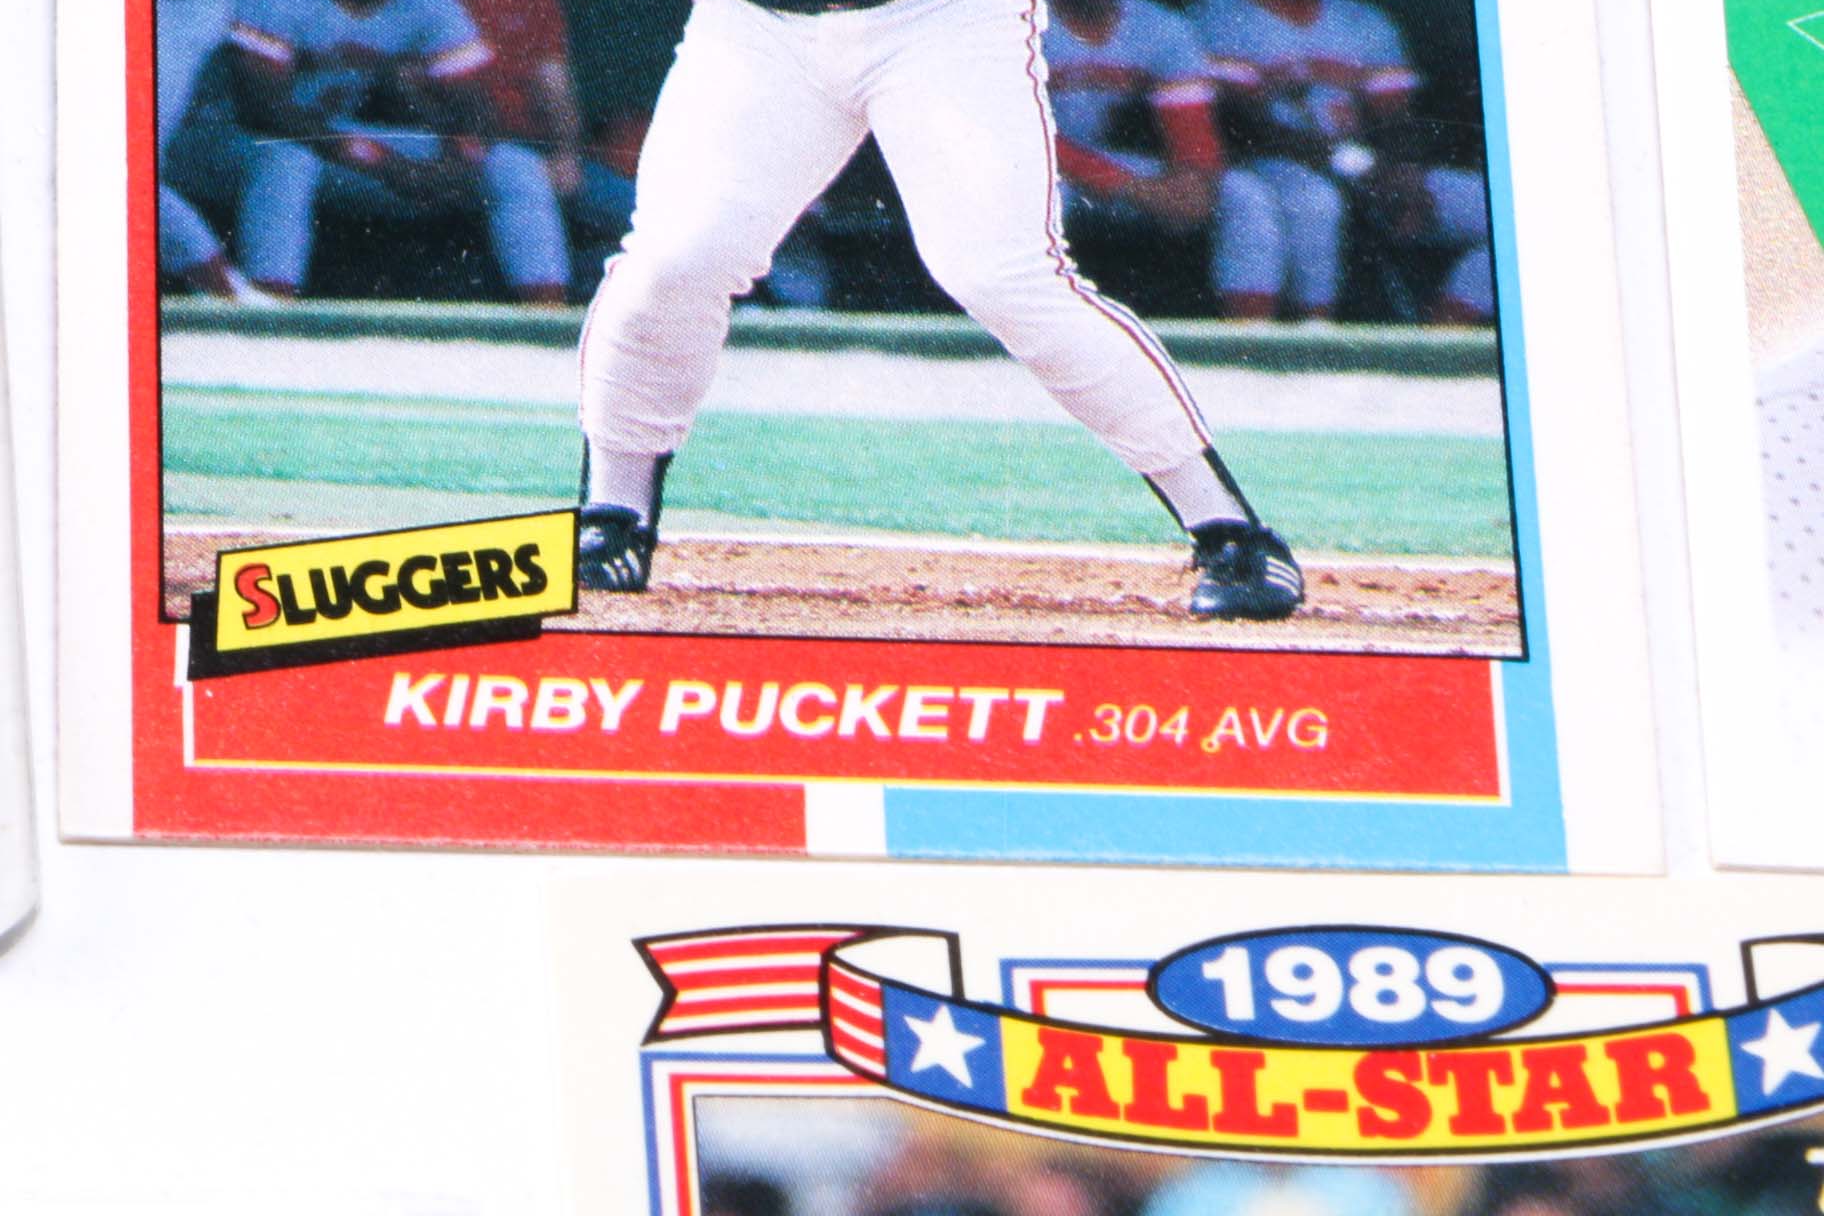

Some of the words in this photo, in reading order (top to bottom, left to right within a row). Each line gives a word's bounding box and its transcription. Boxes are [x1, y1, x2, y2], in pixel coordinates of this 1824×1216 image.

[235, 542, 548, 630] SLUGGERS
[384, 675, 642, 731] KIRBY
[660, 684, 1064, 741] PUCKETT
[1073, 702, 1190, 745] .304
[1201, 706, 1329, 753] AVG
[1201, 945, 1505, 1023] 1989
[1023, 1028, 1708, 1138] ALL-STAR
